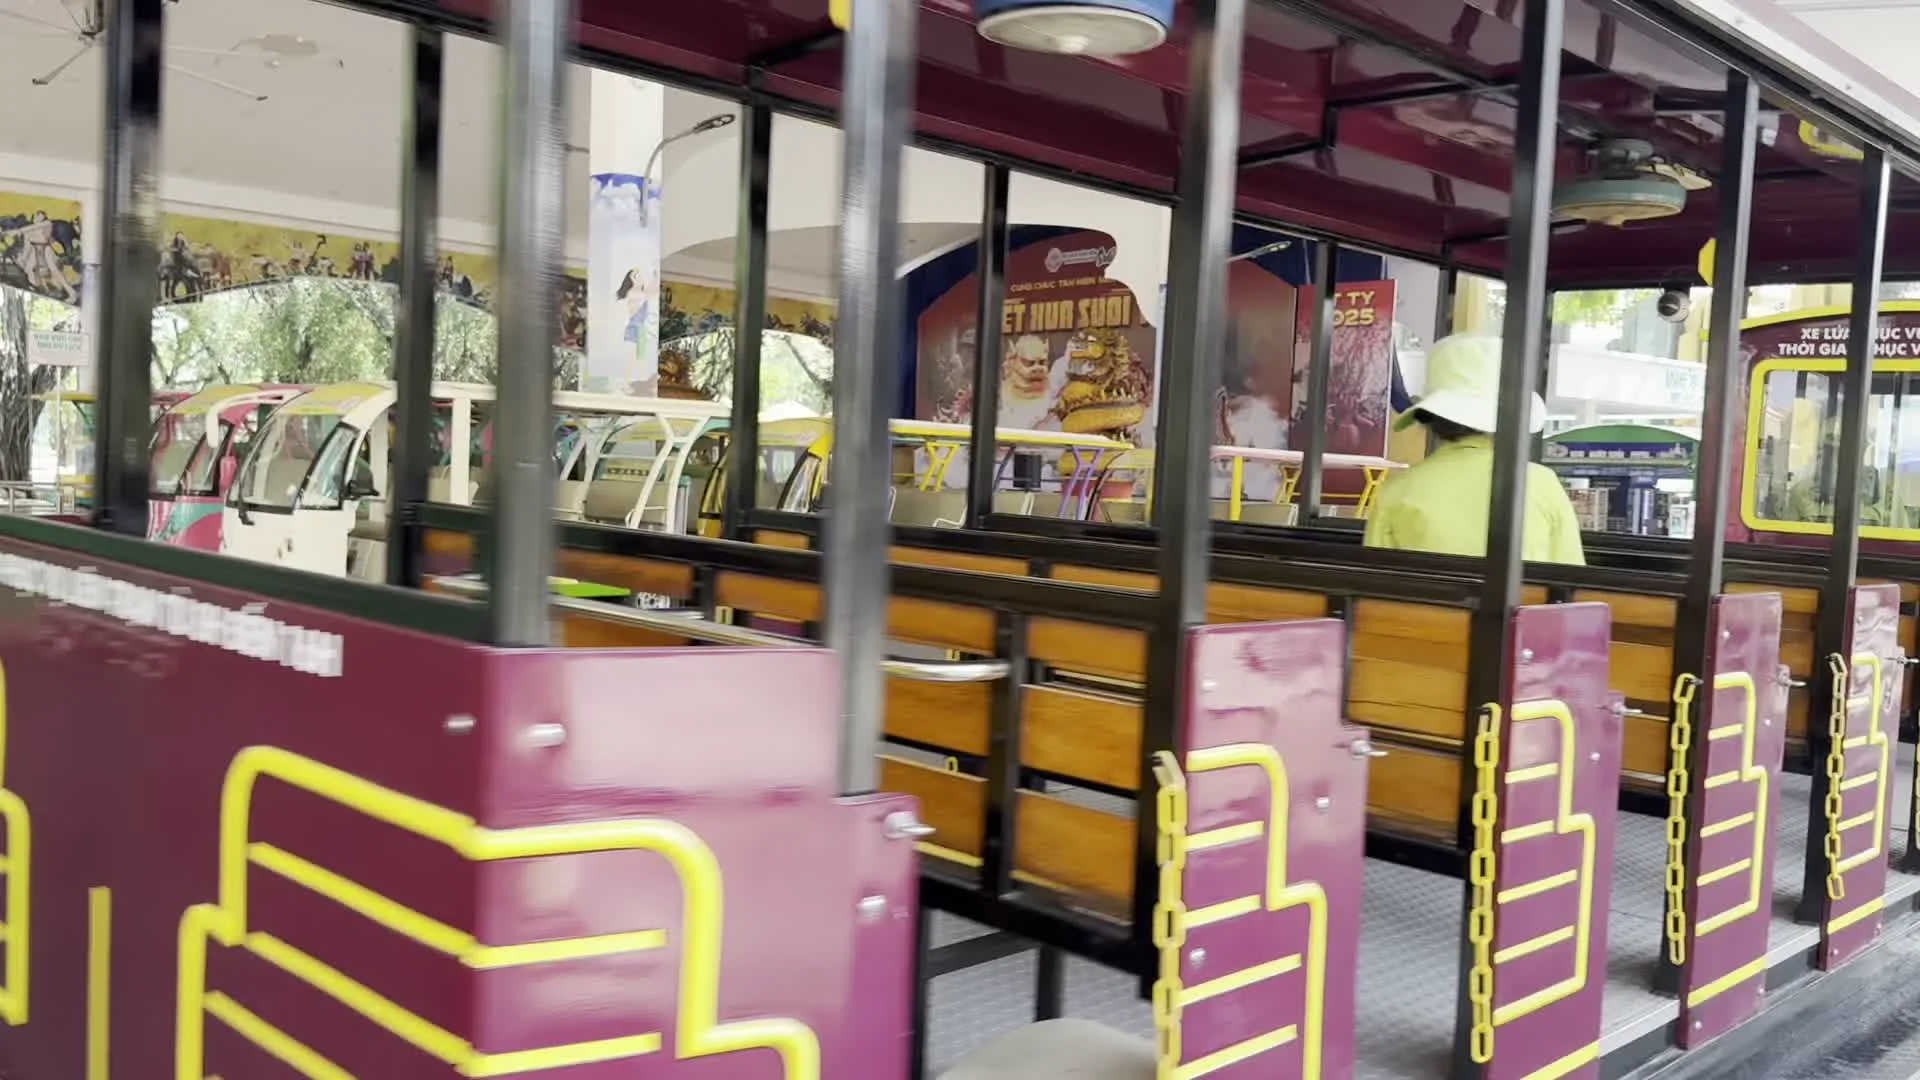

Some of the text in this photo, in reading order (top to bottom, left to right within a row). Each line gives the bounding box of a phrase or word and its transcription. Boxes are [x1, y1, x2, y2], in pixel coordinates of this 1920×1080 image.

[1334, 308, 1374, 326] 025
[1801, 327, 1820, 340] XE
[1873, 343, 1907, 358] HỤC
